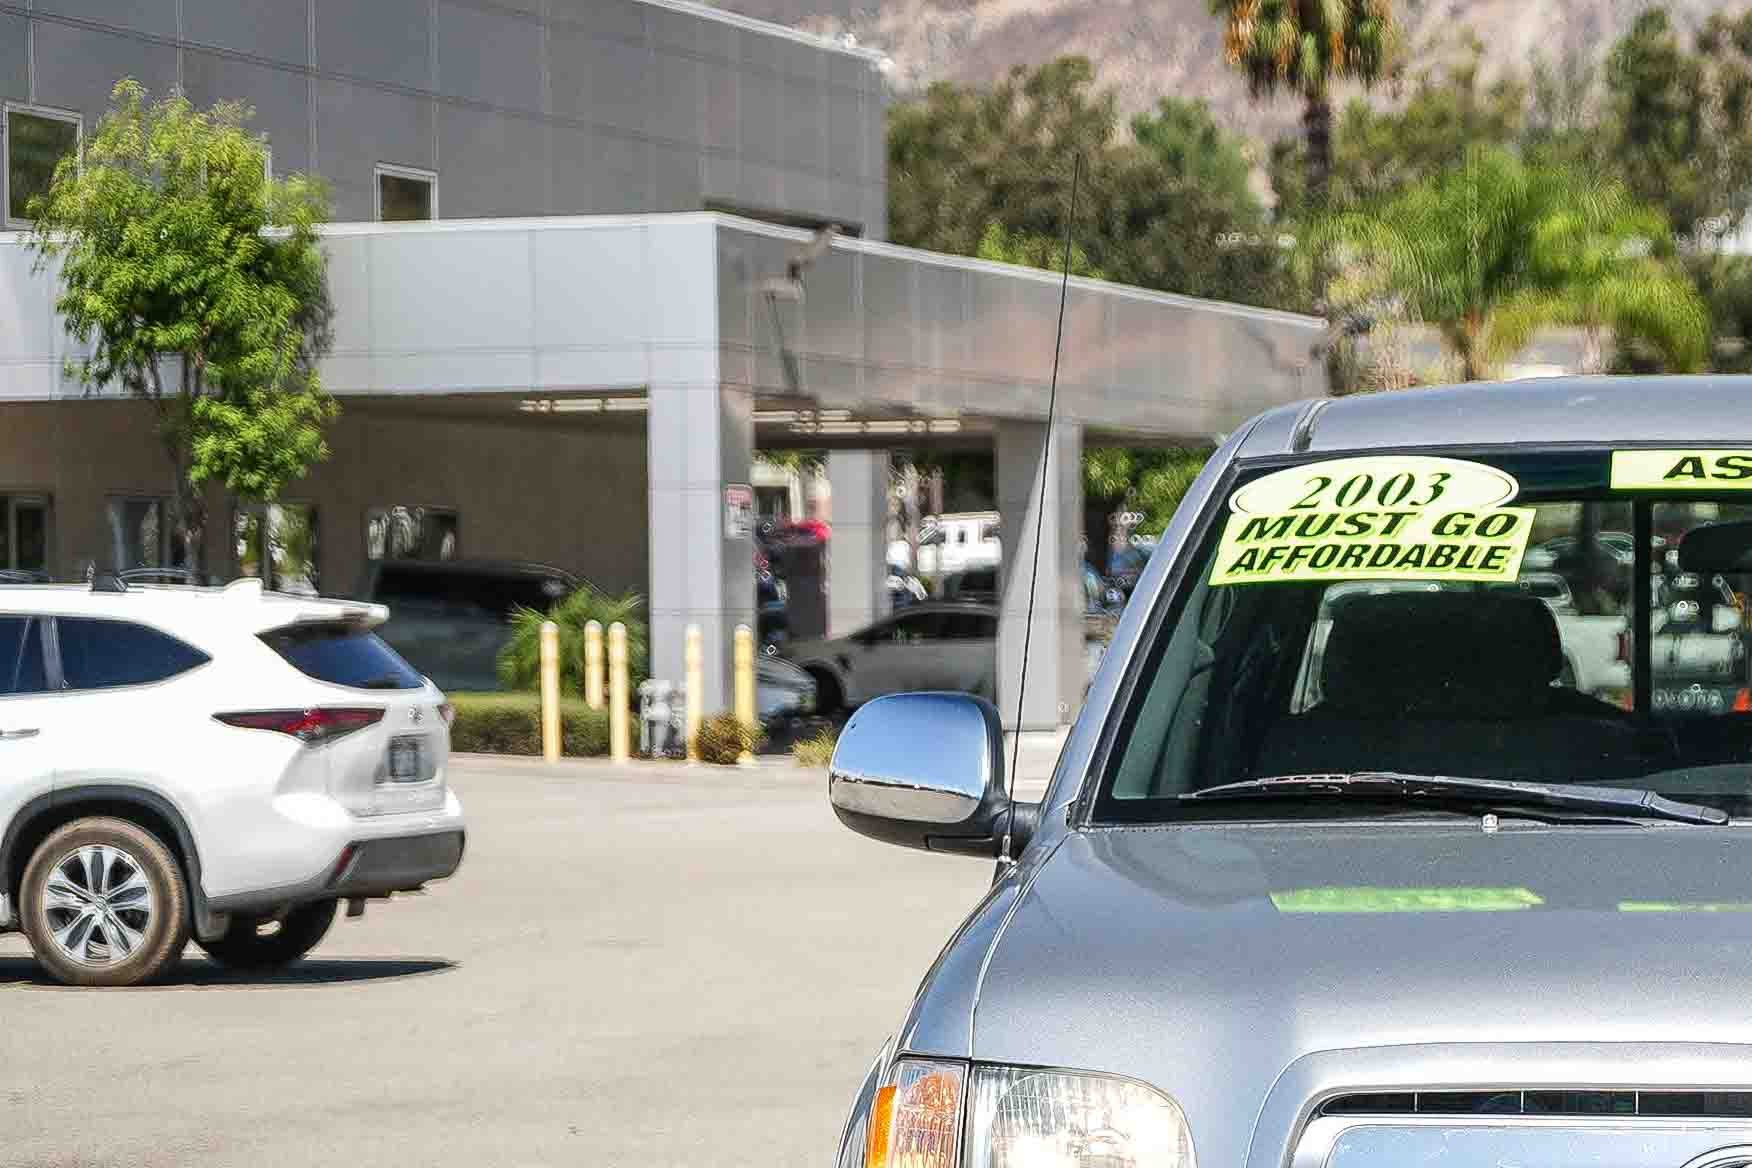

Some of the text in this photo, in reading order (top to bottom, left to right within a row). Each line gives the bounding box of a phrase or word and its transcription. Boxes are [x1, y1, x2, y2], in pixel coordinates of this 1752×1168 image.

[1289, 472, 1451, 510] 2003
[1235, 511, 1518, 541] MUST GO
[1226, 543, 1511, 573] AFFORDABLE
